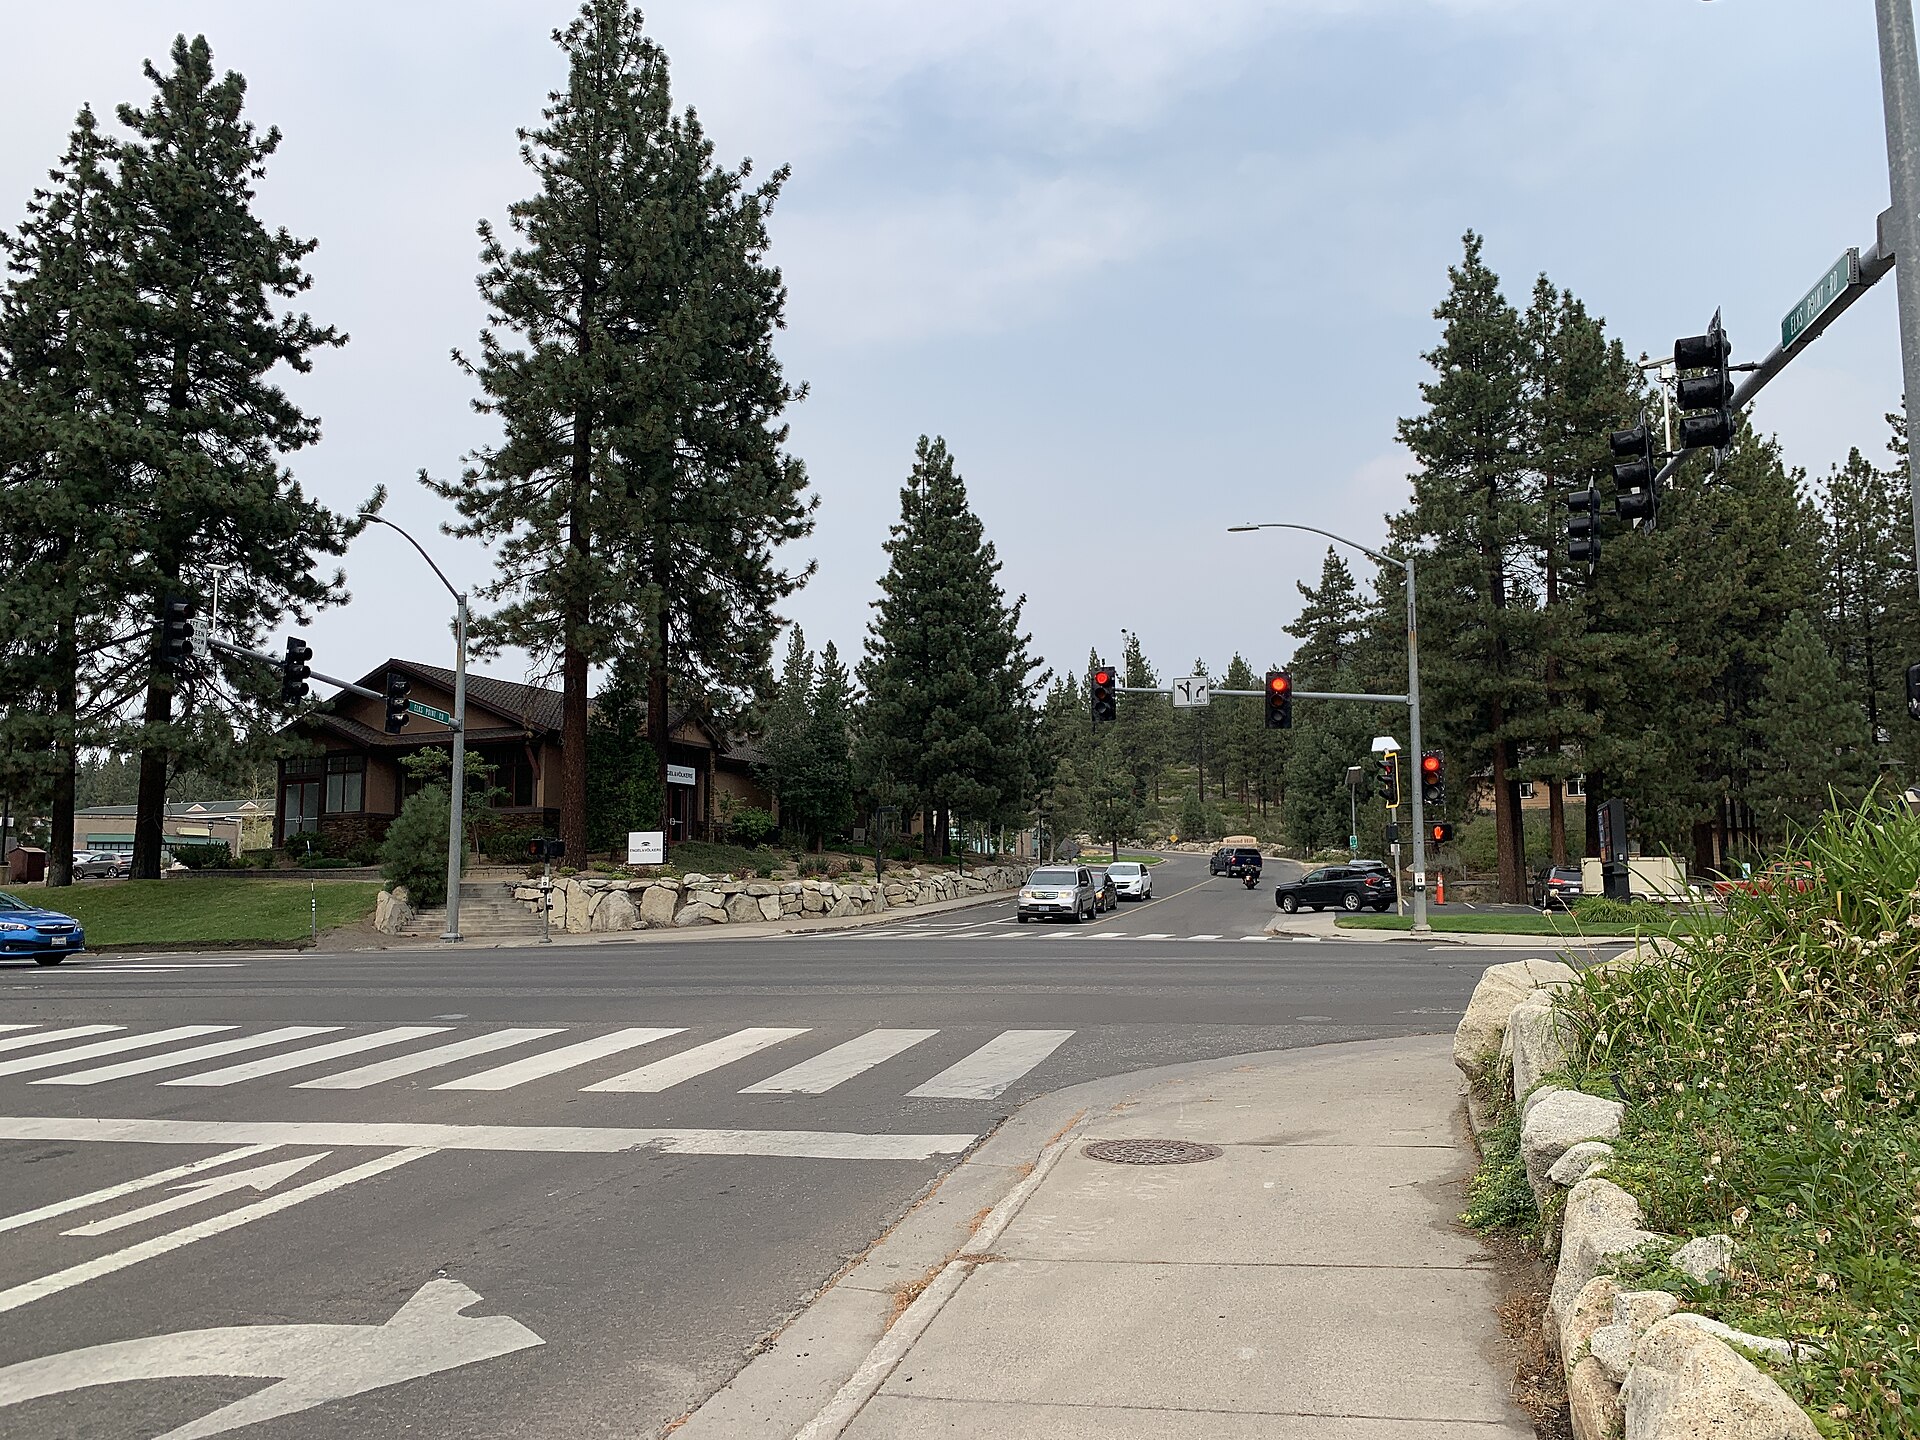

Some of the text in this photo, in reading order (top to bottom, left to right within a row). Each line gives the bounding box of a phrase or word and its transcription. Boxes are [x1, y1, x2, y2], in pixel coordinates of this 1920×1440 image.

[1790, 269, 1839, 336] ELKS POINT RD
[425, 707, 437, 718] POINT
